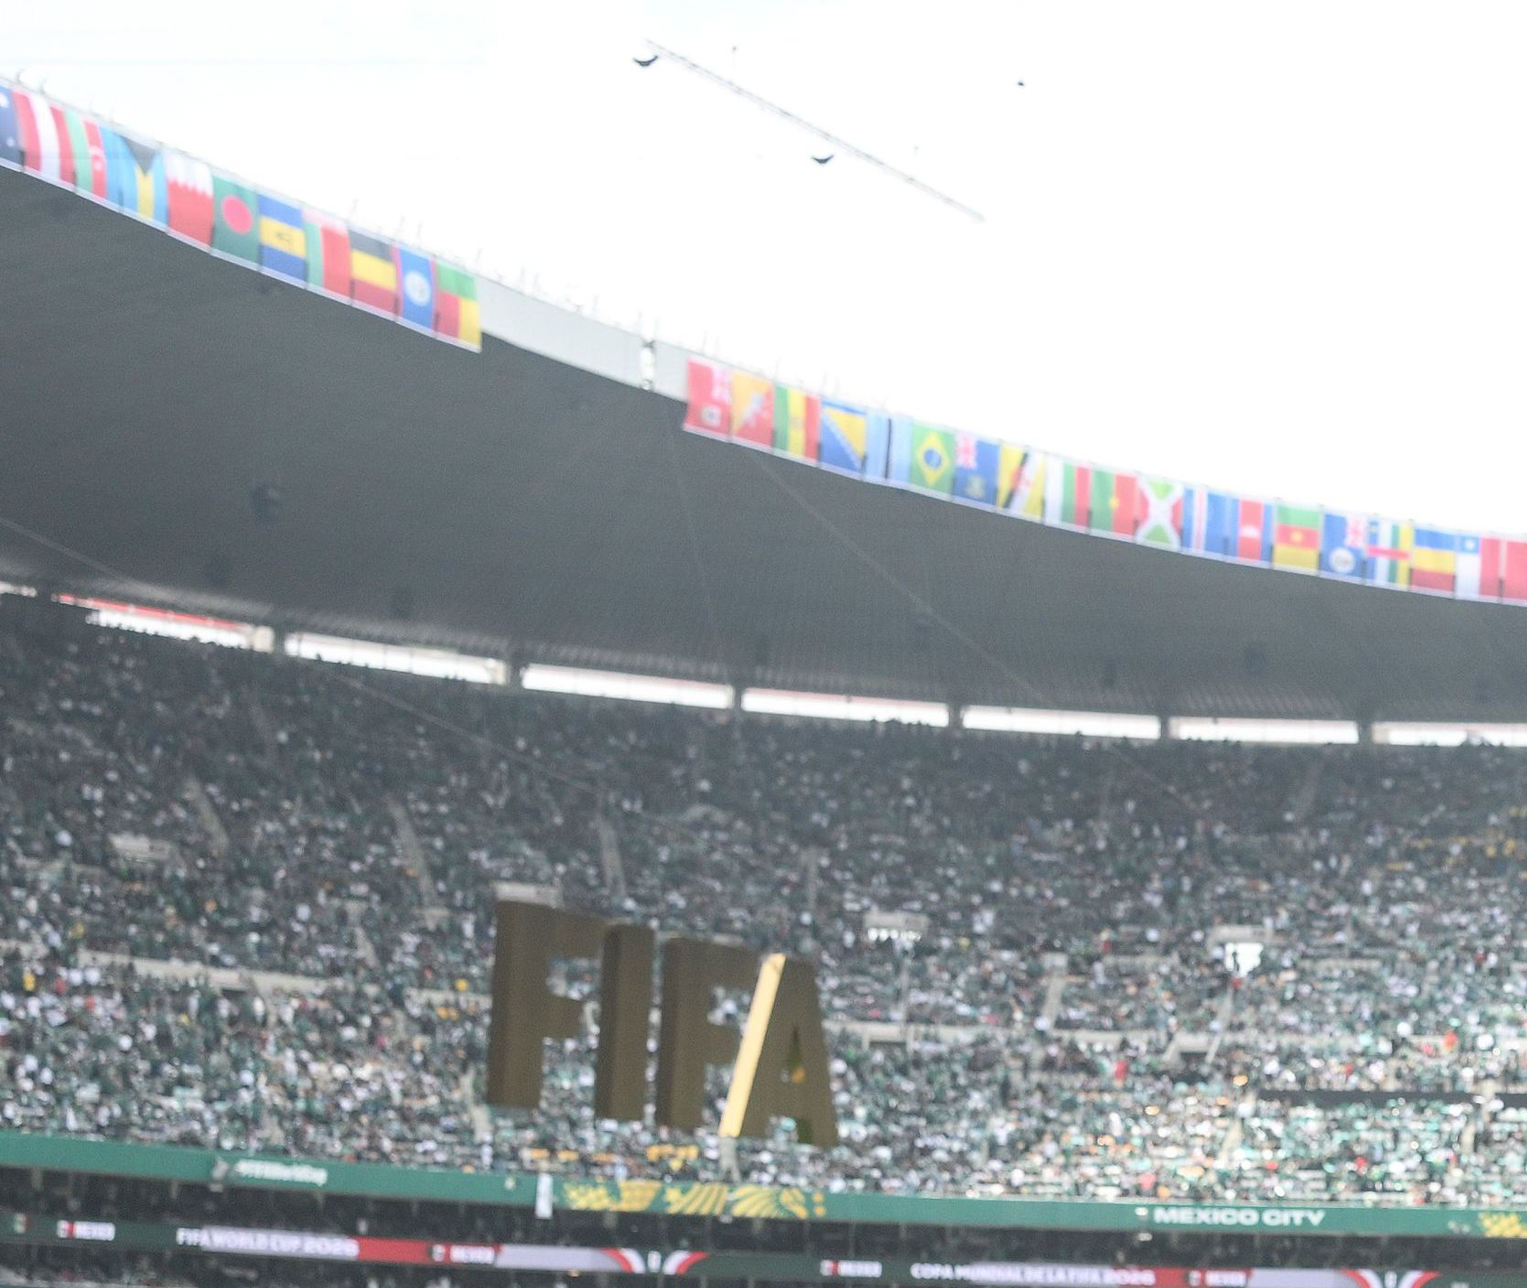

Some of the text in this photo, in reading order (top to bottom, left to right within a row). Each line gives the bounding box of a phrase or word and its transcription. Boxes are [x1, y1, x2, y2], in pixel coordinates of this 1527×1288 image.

[486, 900, 840, 1150] FIFA
[1152, 1207, 1325, 1227] MEXICO CITY
